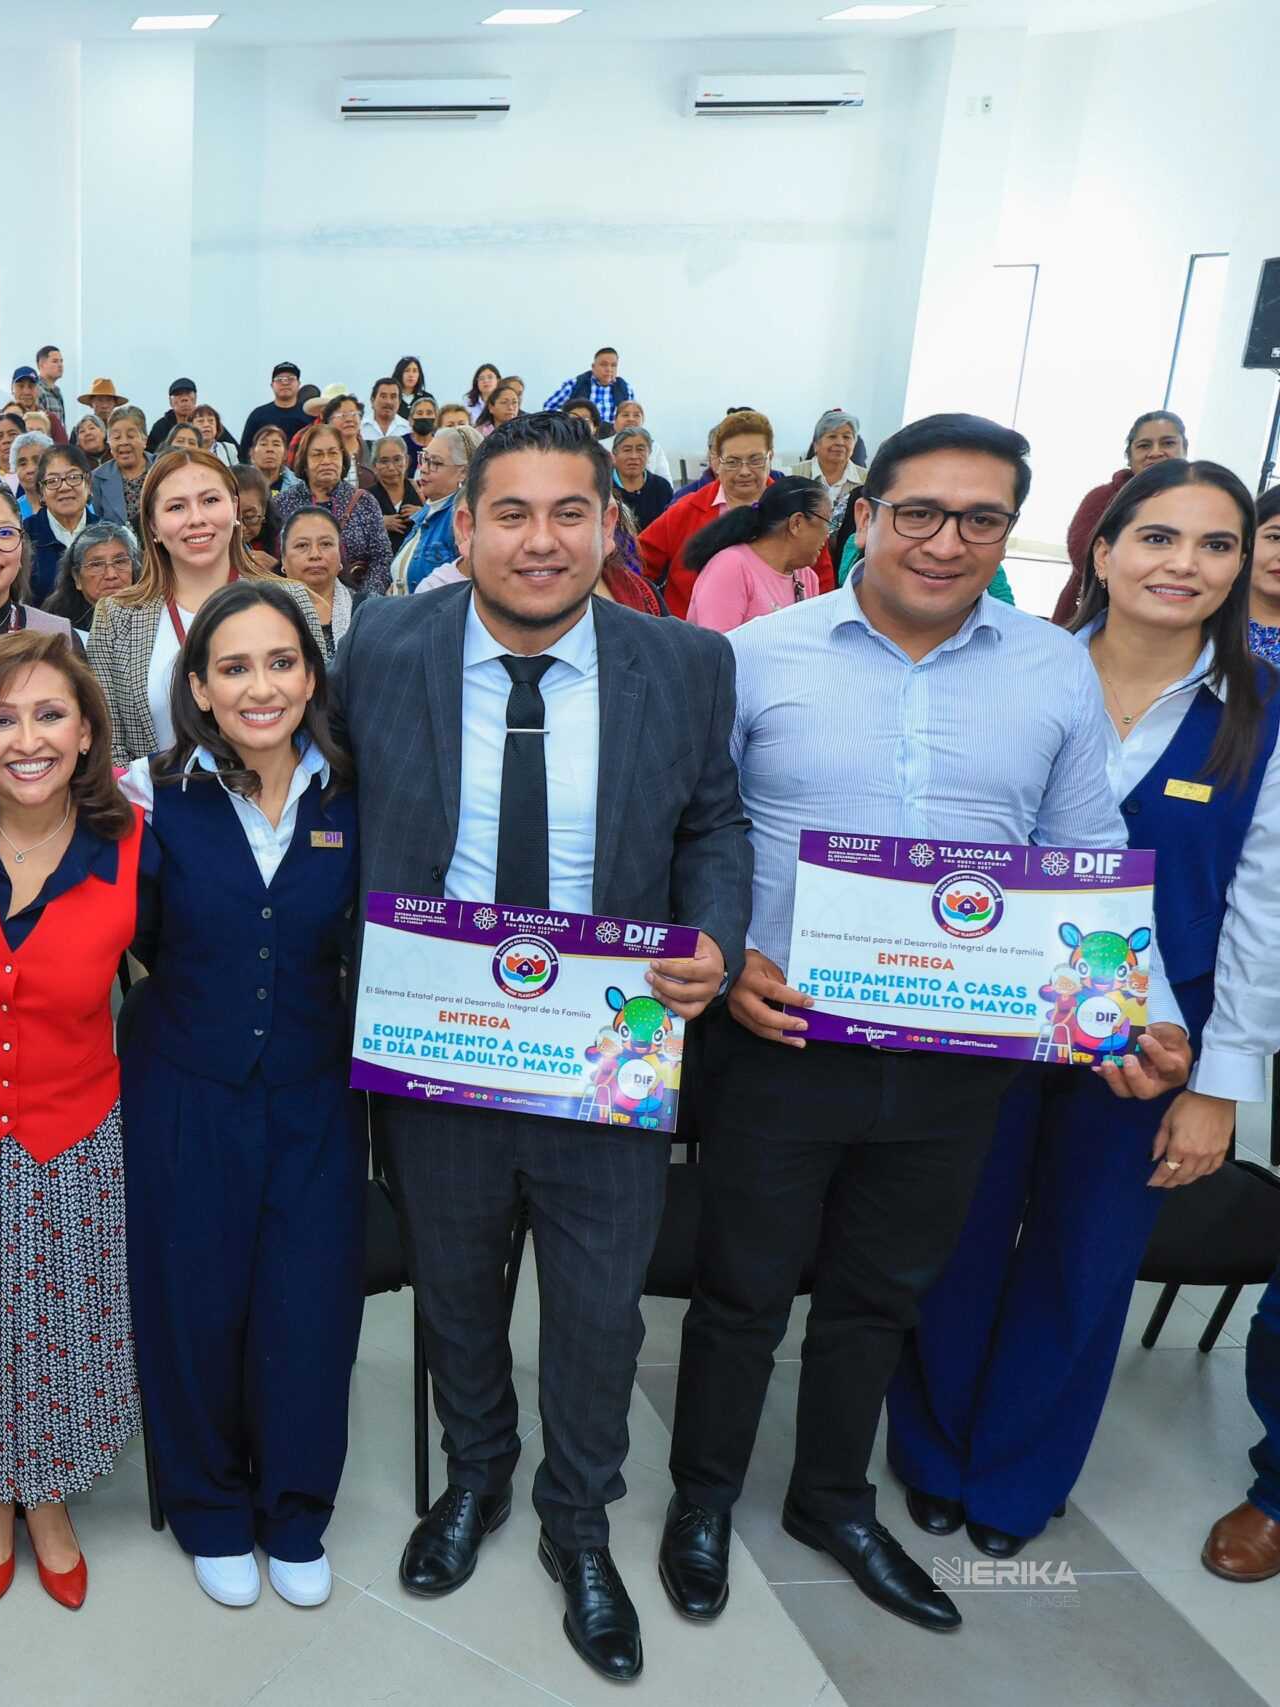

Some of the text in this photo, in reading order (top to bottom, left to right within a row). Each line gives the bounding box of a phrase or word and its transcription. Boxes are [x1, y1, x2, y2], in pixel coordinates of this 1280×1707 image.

[828, 836, 880, 850] SNDIF
[938, 847, 1012, 860] TLAXCALA
[1073, 851, 1122, 874] DIF
[395, 897, 446, 913] SNDIF
[501, 911, 570, 927] TLAXCALA
[623, 923, 667, 946] DIF
[809, 930, 842, 940] Sistema
[843, 933, 871, 942] Estatal
[872, 936, 892, 945] para
[903, 938, 947, 949] Desarrollo
[949, 942, 984, 953] Integral
[1010, 946, 1043, 956] Familia
[877, 952, 955, 970] ENTREGA
[809, 968, 1027, 998] EQUIPAMIENTO A CASAS
[374, 986, 405, 997] Sistema
[406, 990, 433, 1000] Estatal
[434, 994, 454, 1004] para
[464, 997, 505, 1009] Desarrollo
[506, 1002, 538, 1014] Integral
[539, 1005, 550, 1014] de
[551, 1007, 561, 1015] la
[561, 1008, 591, 1018] Familia
[798, 981, 1037, 1016] DE DÍA DEL ADULTO MAYOR
[438, 1010, 511, 1029] ENTREGA
[1095, 1011, 1117, 1022] DIF
[372, 1023, 575, 1058] EQUIPAMIENTO A CASAS
[361, 1037, 583, 1076] DE DÍA DEL ADULTO MAYOR
[633, 1074, 653, 1084] DIF
